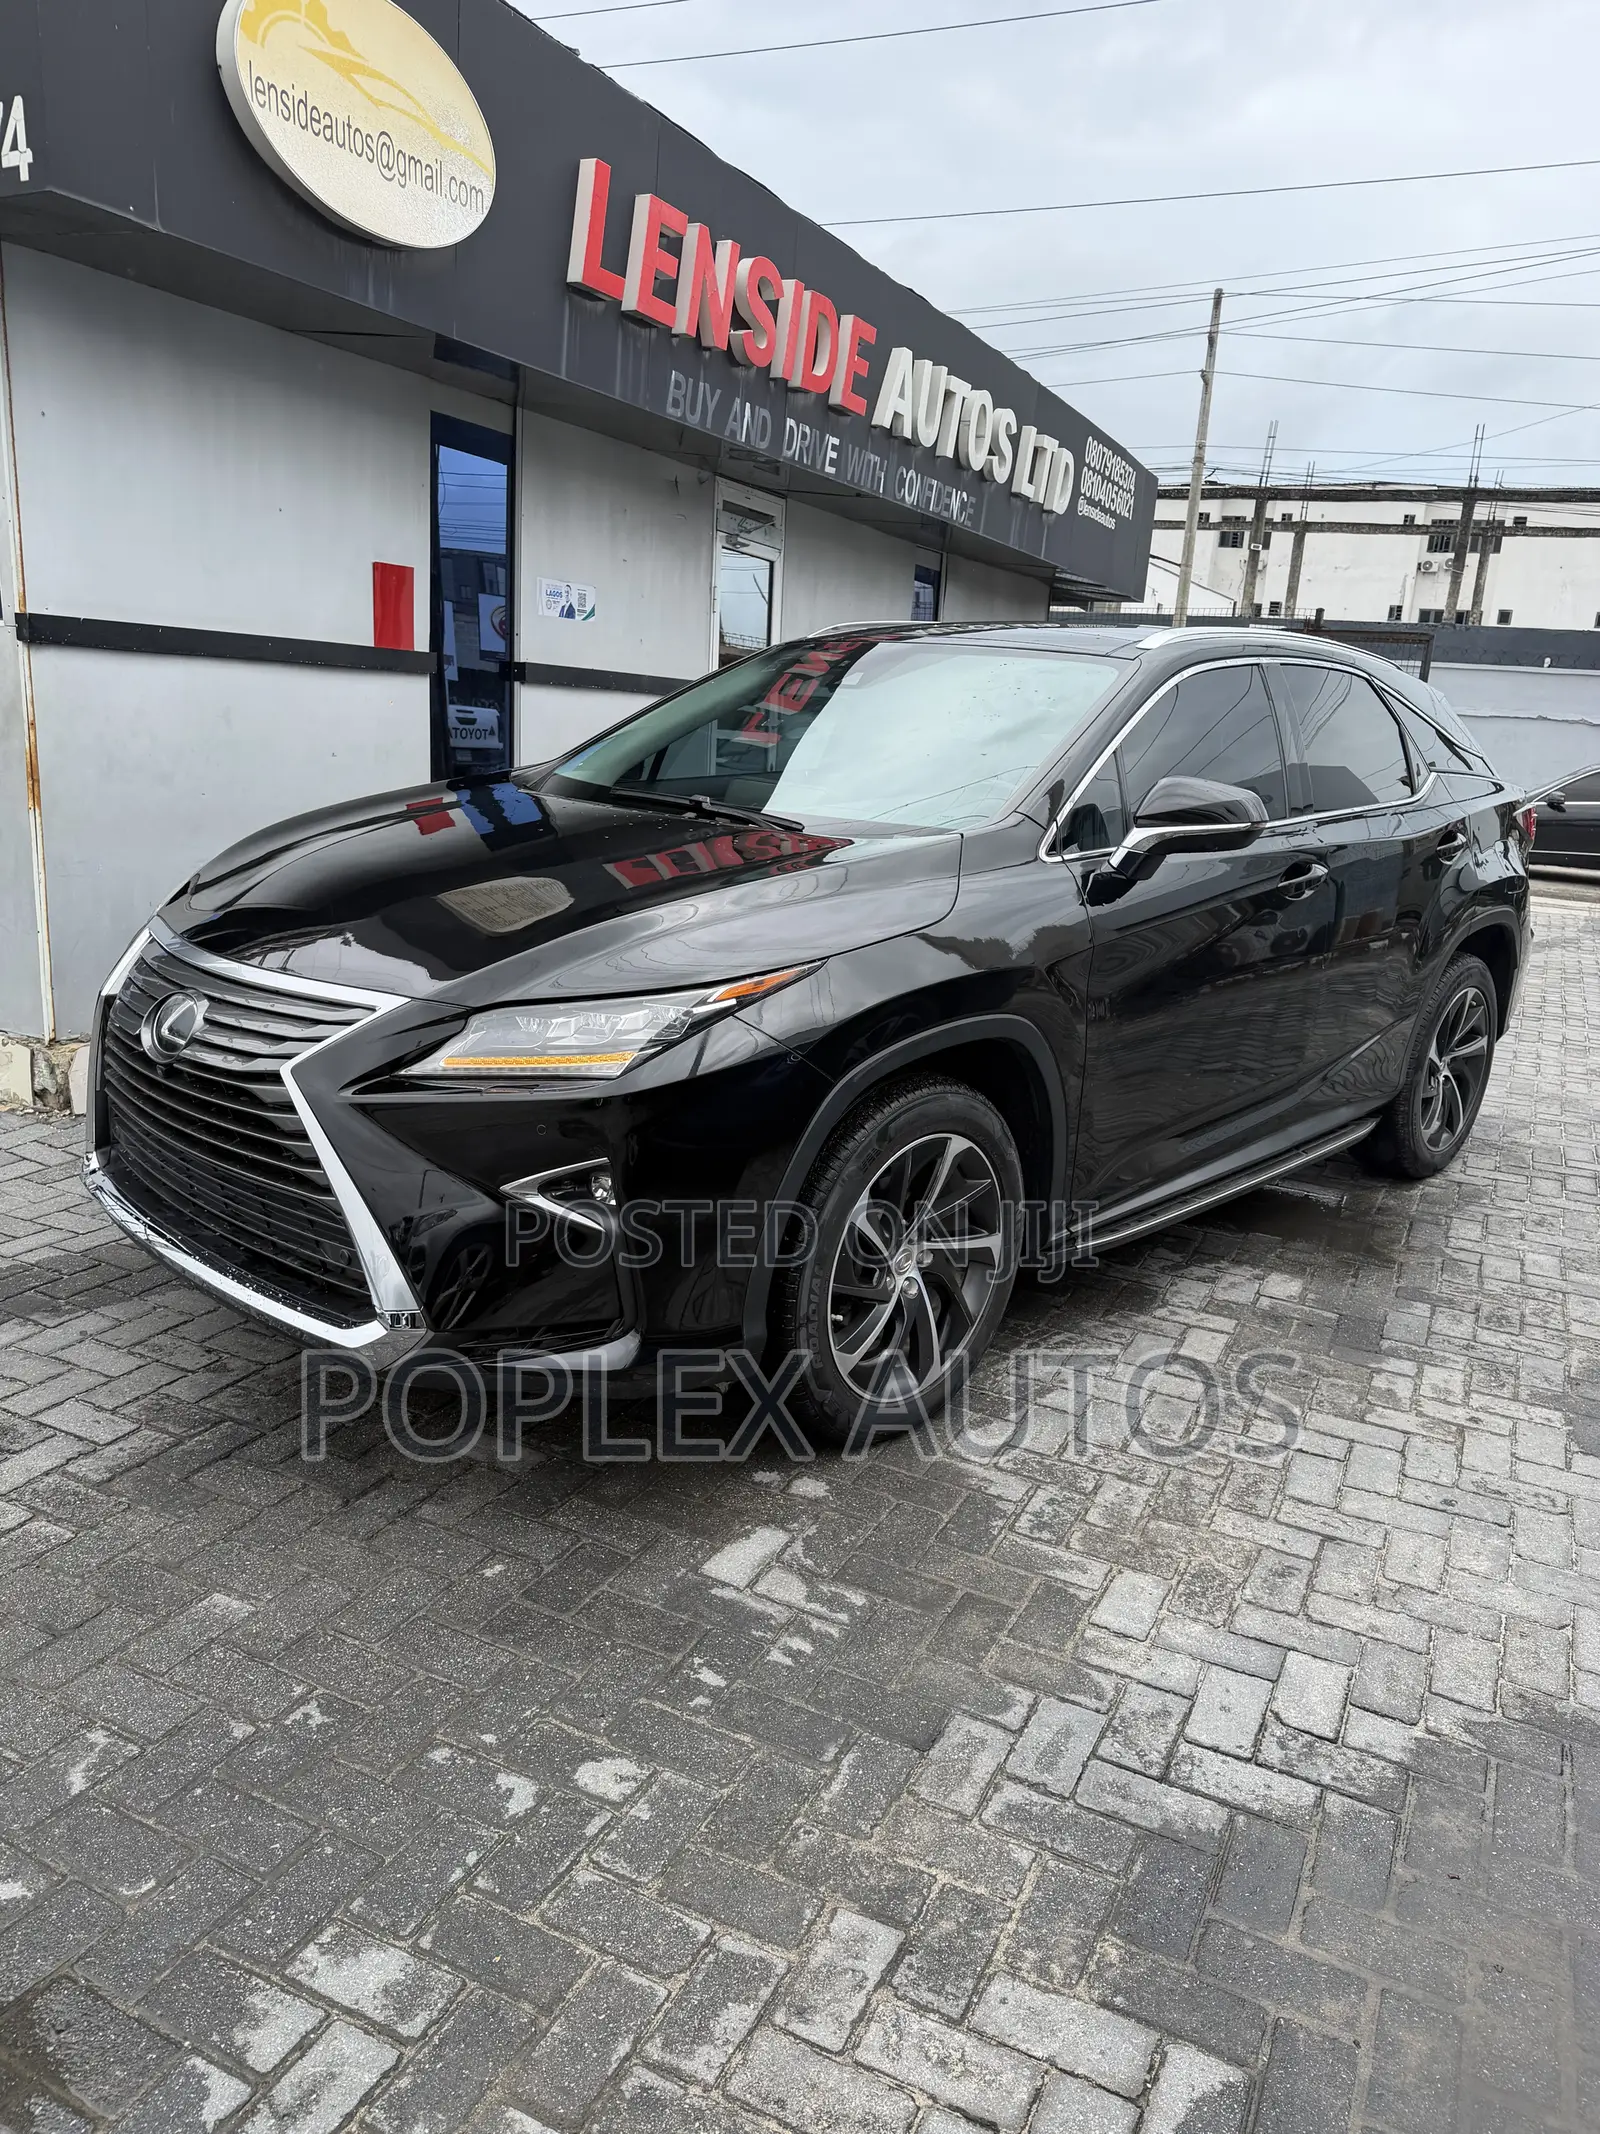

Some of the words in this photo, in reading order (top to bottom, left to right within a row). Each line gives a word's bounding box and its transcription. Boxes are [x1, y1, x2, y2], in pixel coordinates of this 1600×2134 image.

[0, 95, 33, 182] 4
[248, 59, 485, 214] lensideautos@gmail.com
[566, 157, 877, 417] LENSIDE
[871, 346, 1017, 484] AUTOS
[1011, 425, 1076, 516] LTD
[665, 369, 722, 429] BUY
[724, 396, 772, 449] AND
[781, 417, 841, 475] DRIVE
[846, 443, 889, 494] WITH
[895, 465, 977, 527] CONFIDENCE
[1080, 465, 1135, 520] 08104056021
[1085, 435, 1137, 496] 08079185374
